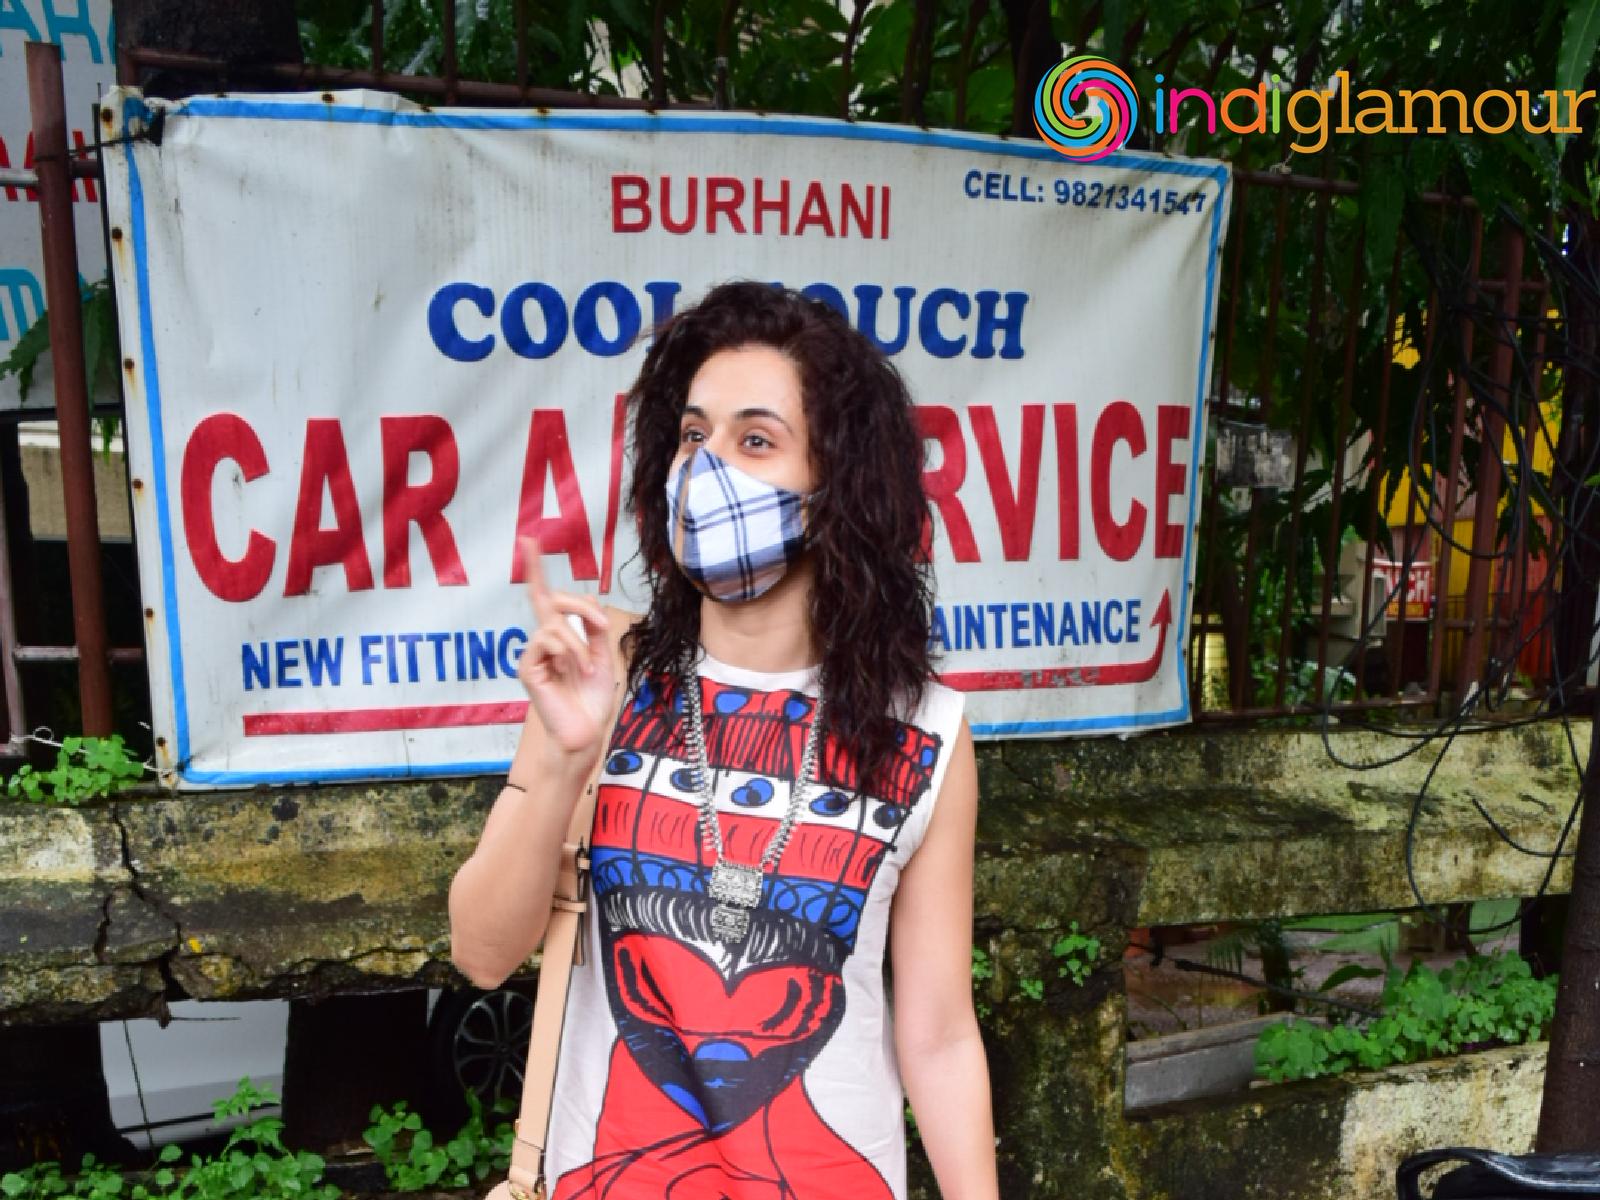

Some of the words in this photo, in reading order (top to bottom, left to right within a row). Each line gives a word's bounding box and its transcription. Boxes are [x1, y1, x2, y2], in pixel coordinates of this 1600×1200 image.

[610, 174, 892, 240] BURHANI
[963, 169, 1044, 204] CELL:
[800, 282, 1030, 360] UCH
[180, 412, 470, 604] CAR
[908, 401, 1192, 563] RVICE
[242, 636, 344, 692] NEW
[926, 599, 1141, 652] AINTENANCE
